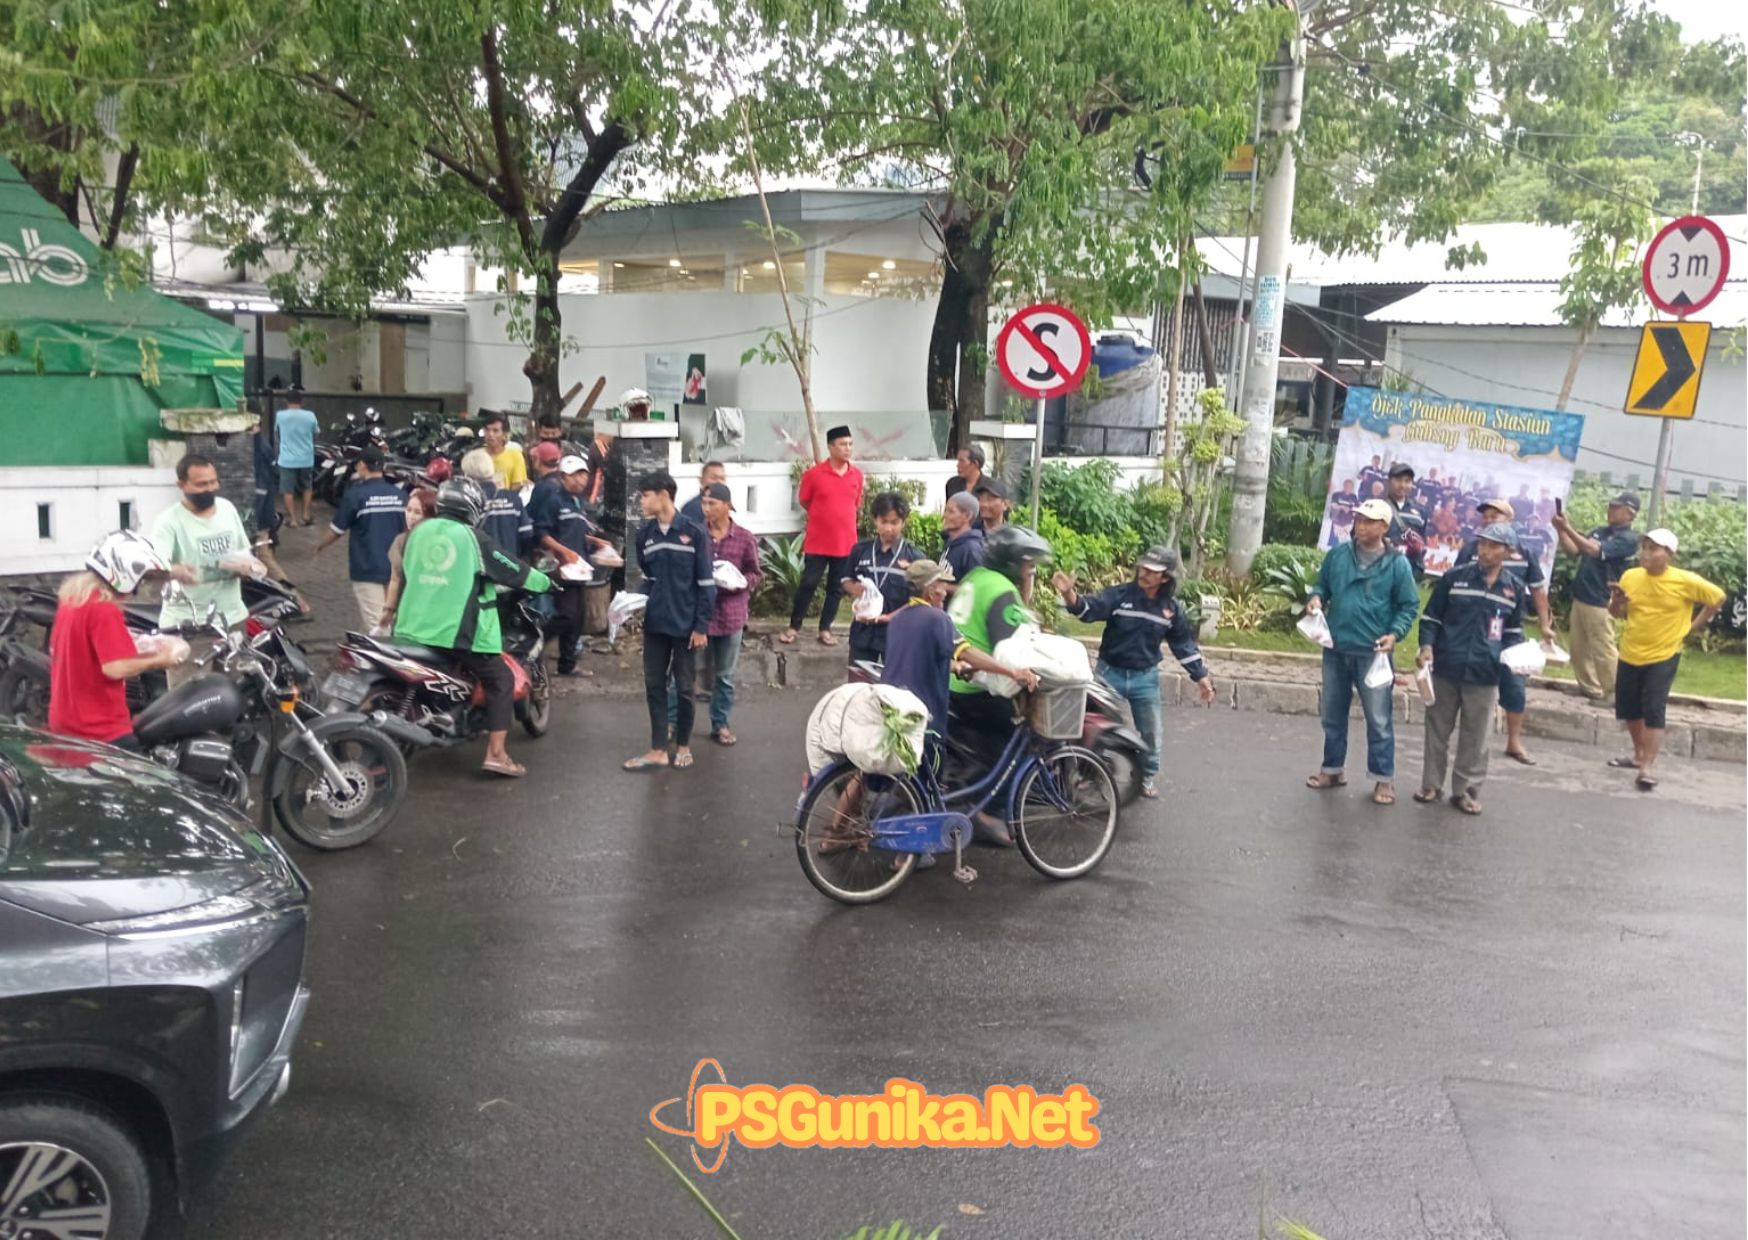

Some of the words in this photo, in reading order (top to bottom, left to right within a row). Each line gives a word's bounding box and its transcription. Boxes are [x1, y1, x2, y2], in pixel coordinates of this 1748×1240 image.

[1667, 252, 1680, 279] 3
[1686, 254, 1709, 277] m
[1026, 322, 1060, 382] S
[1372, 393, 1403, 419] Ojek
[1409, 398, 1487, 426] Pangkalan
[1492, 408, 1551, 435] Stasiun
